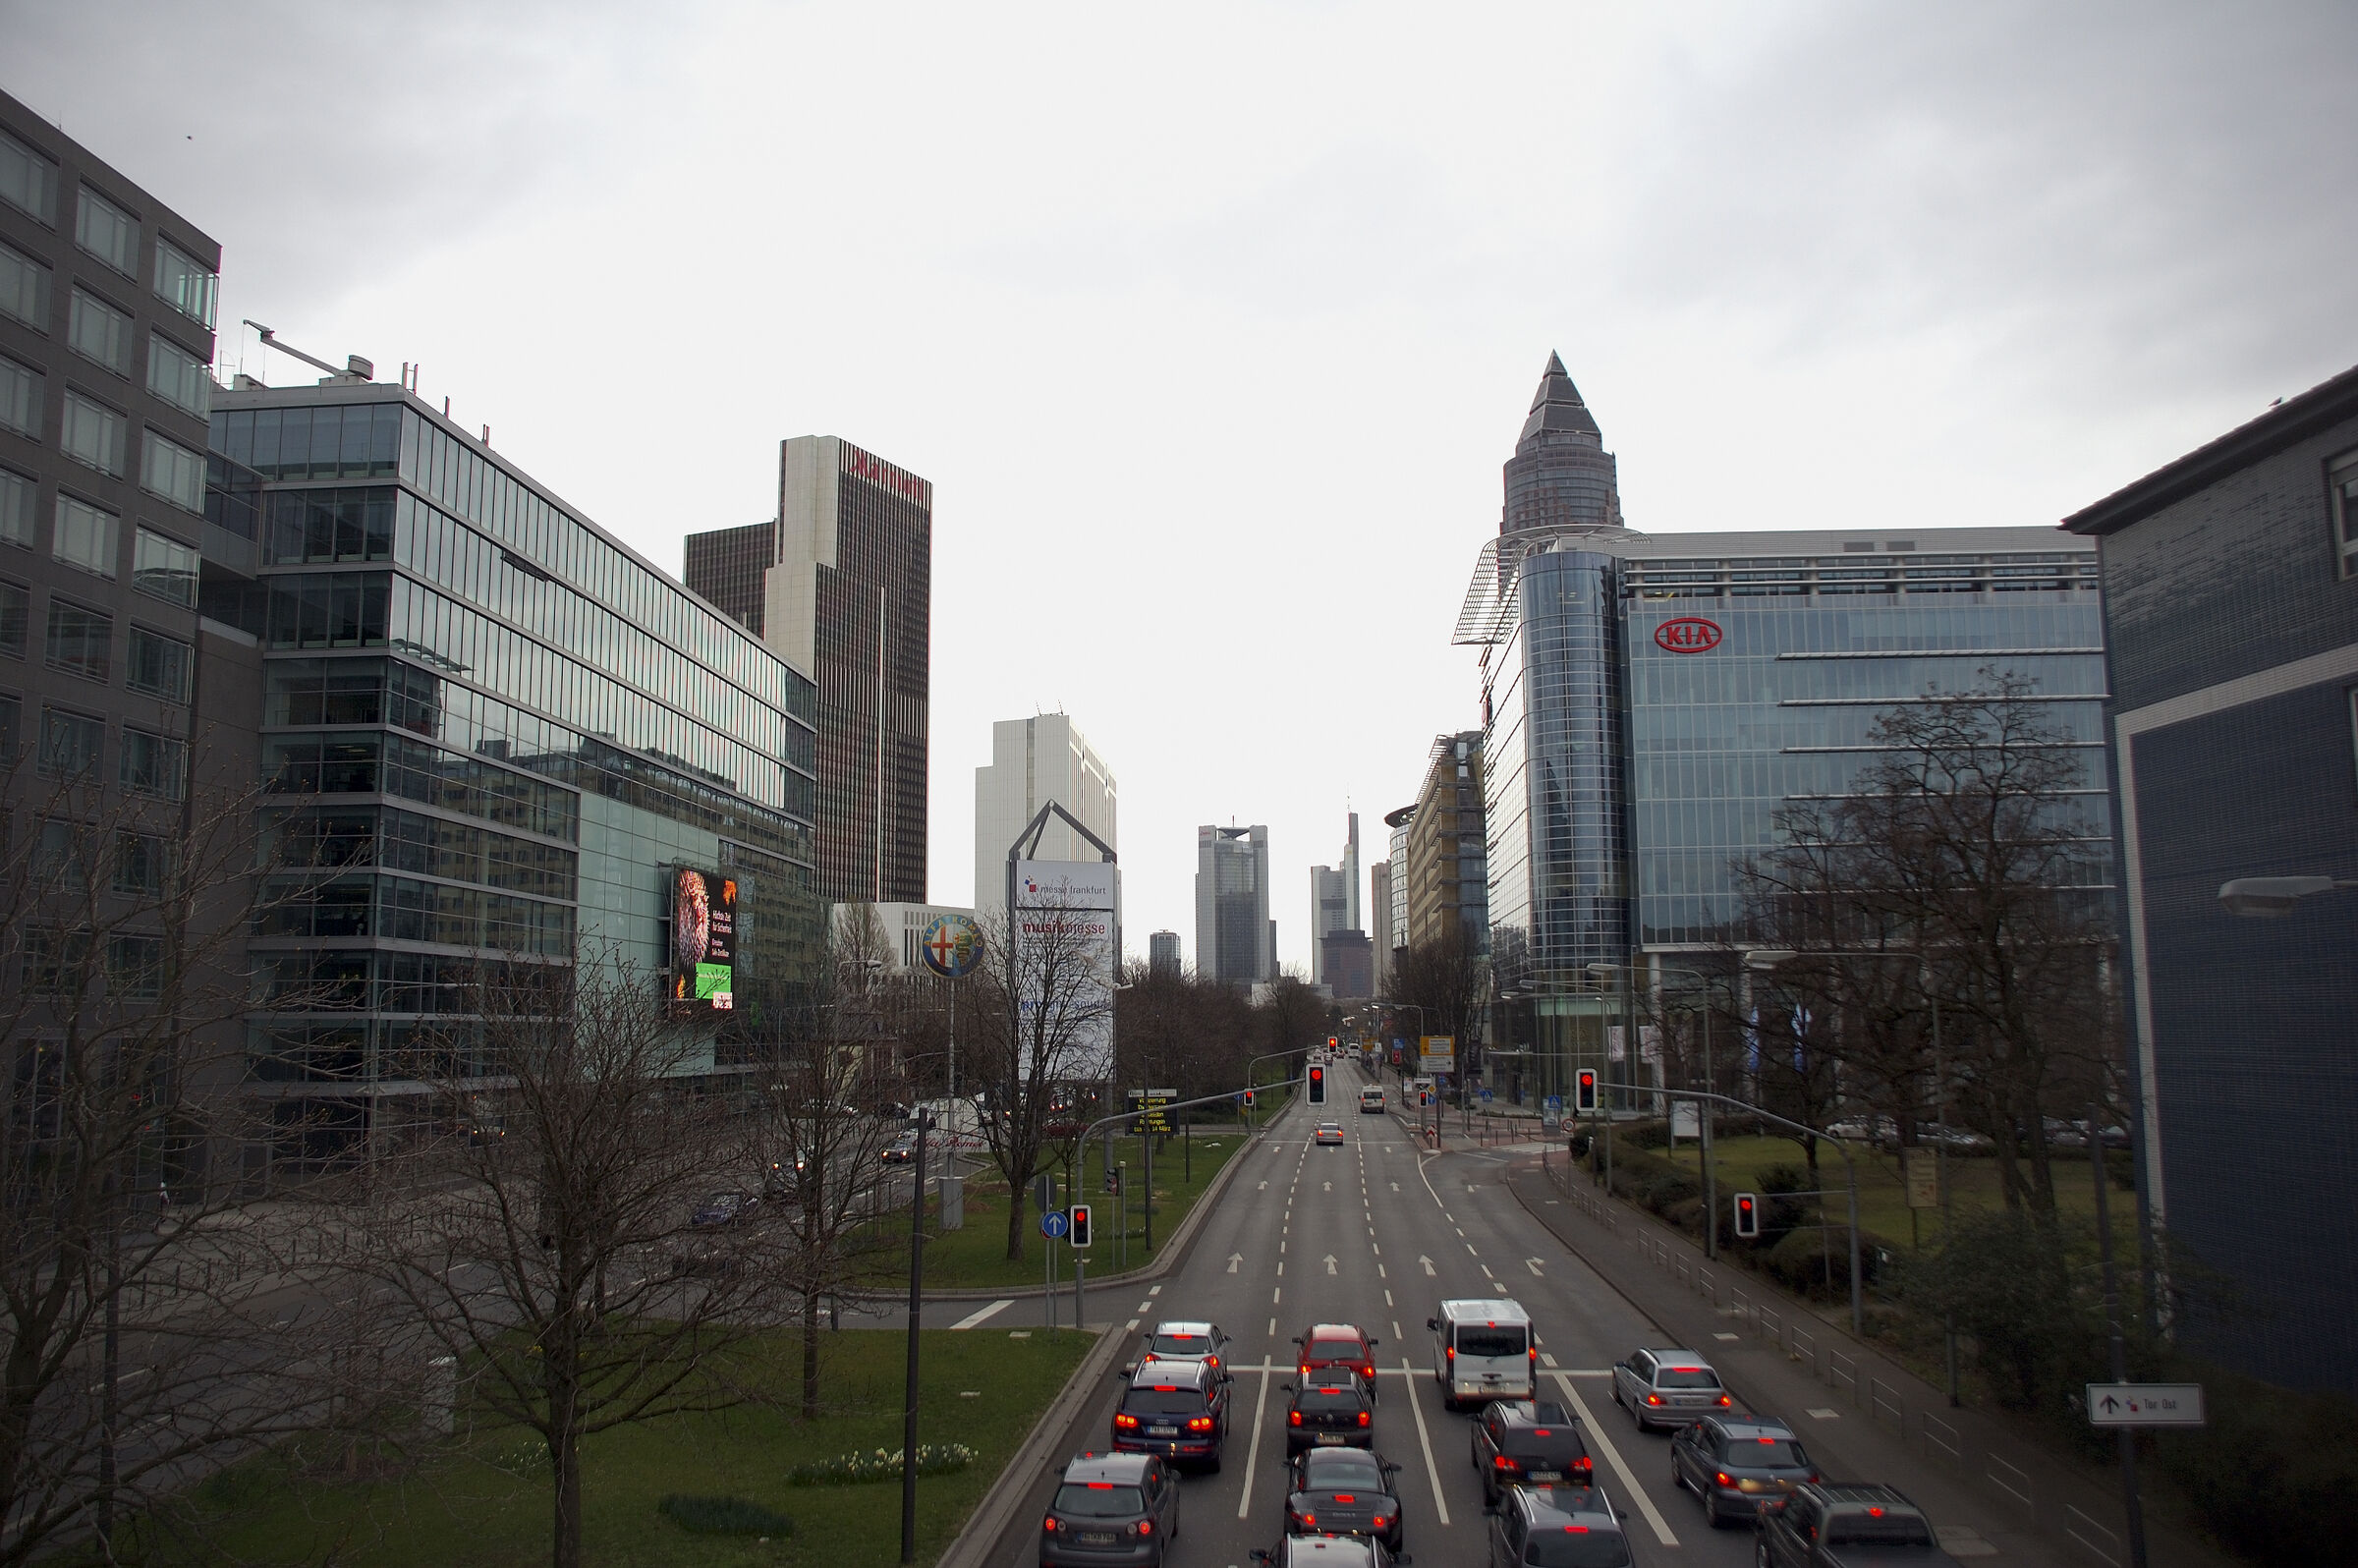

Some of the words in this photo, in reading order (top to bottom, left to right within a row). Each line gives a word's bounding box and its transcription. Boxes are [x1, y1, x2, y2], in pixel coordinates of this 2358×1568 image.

[849, 449, 925, 502] Marriott
[1666, 625, 1712, 644] KIA
[1070, 885, 1106, 895] frankfurt
[924, 919, 944, 946] ALFA
[1022, 919, 1105, 934] musikmesse
[2144, 1398, 2158, 1409] Tor
[2162, 1398, 2177, 1409] Ost
